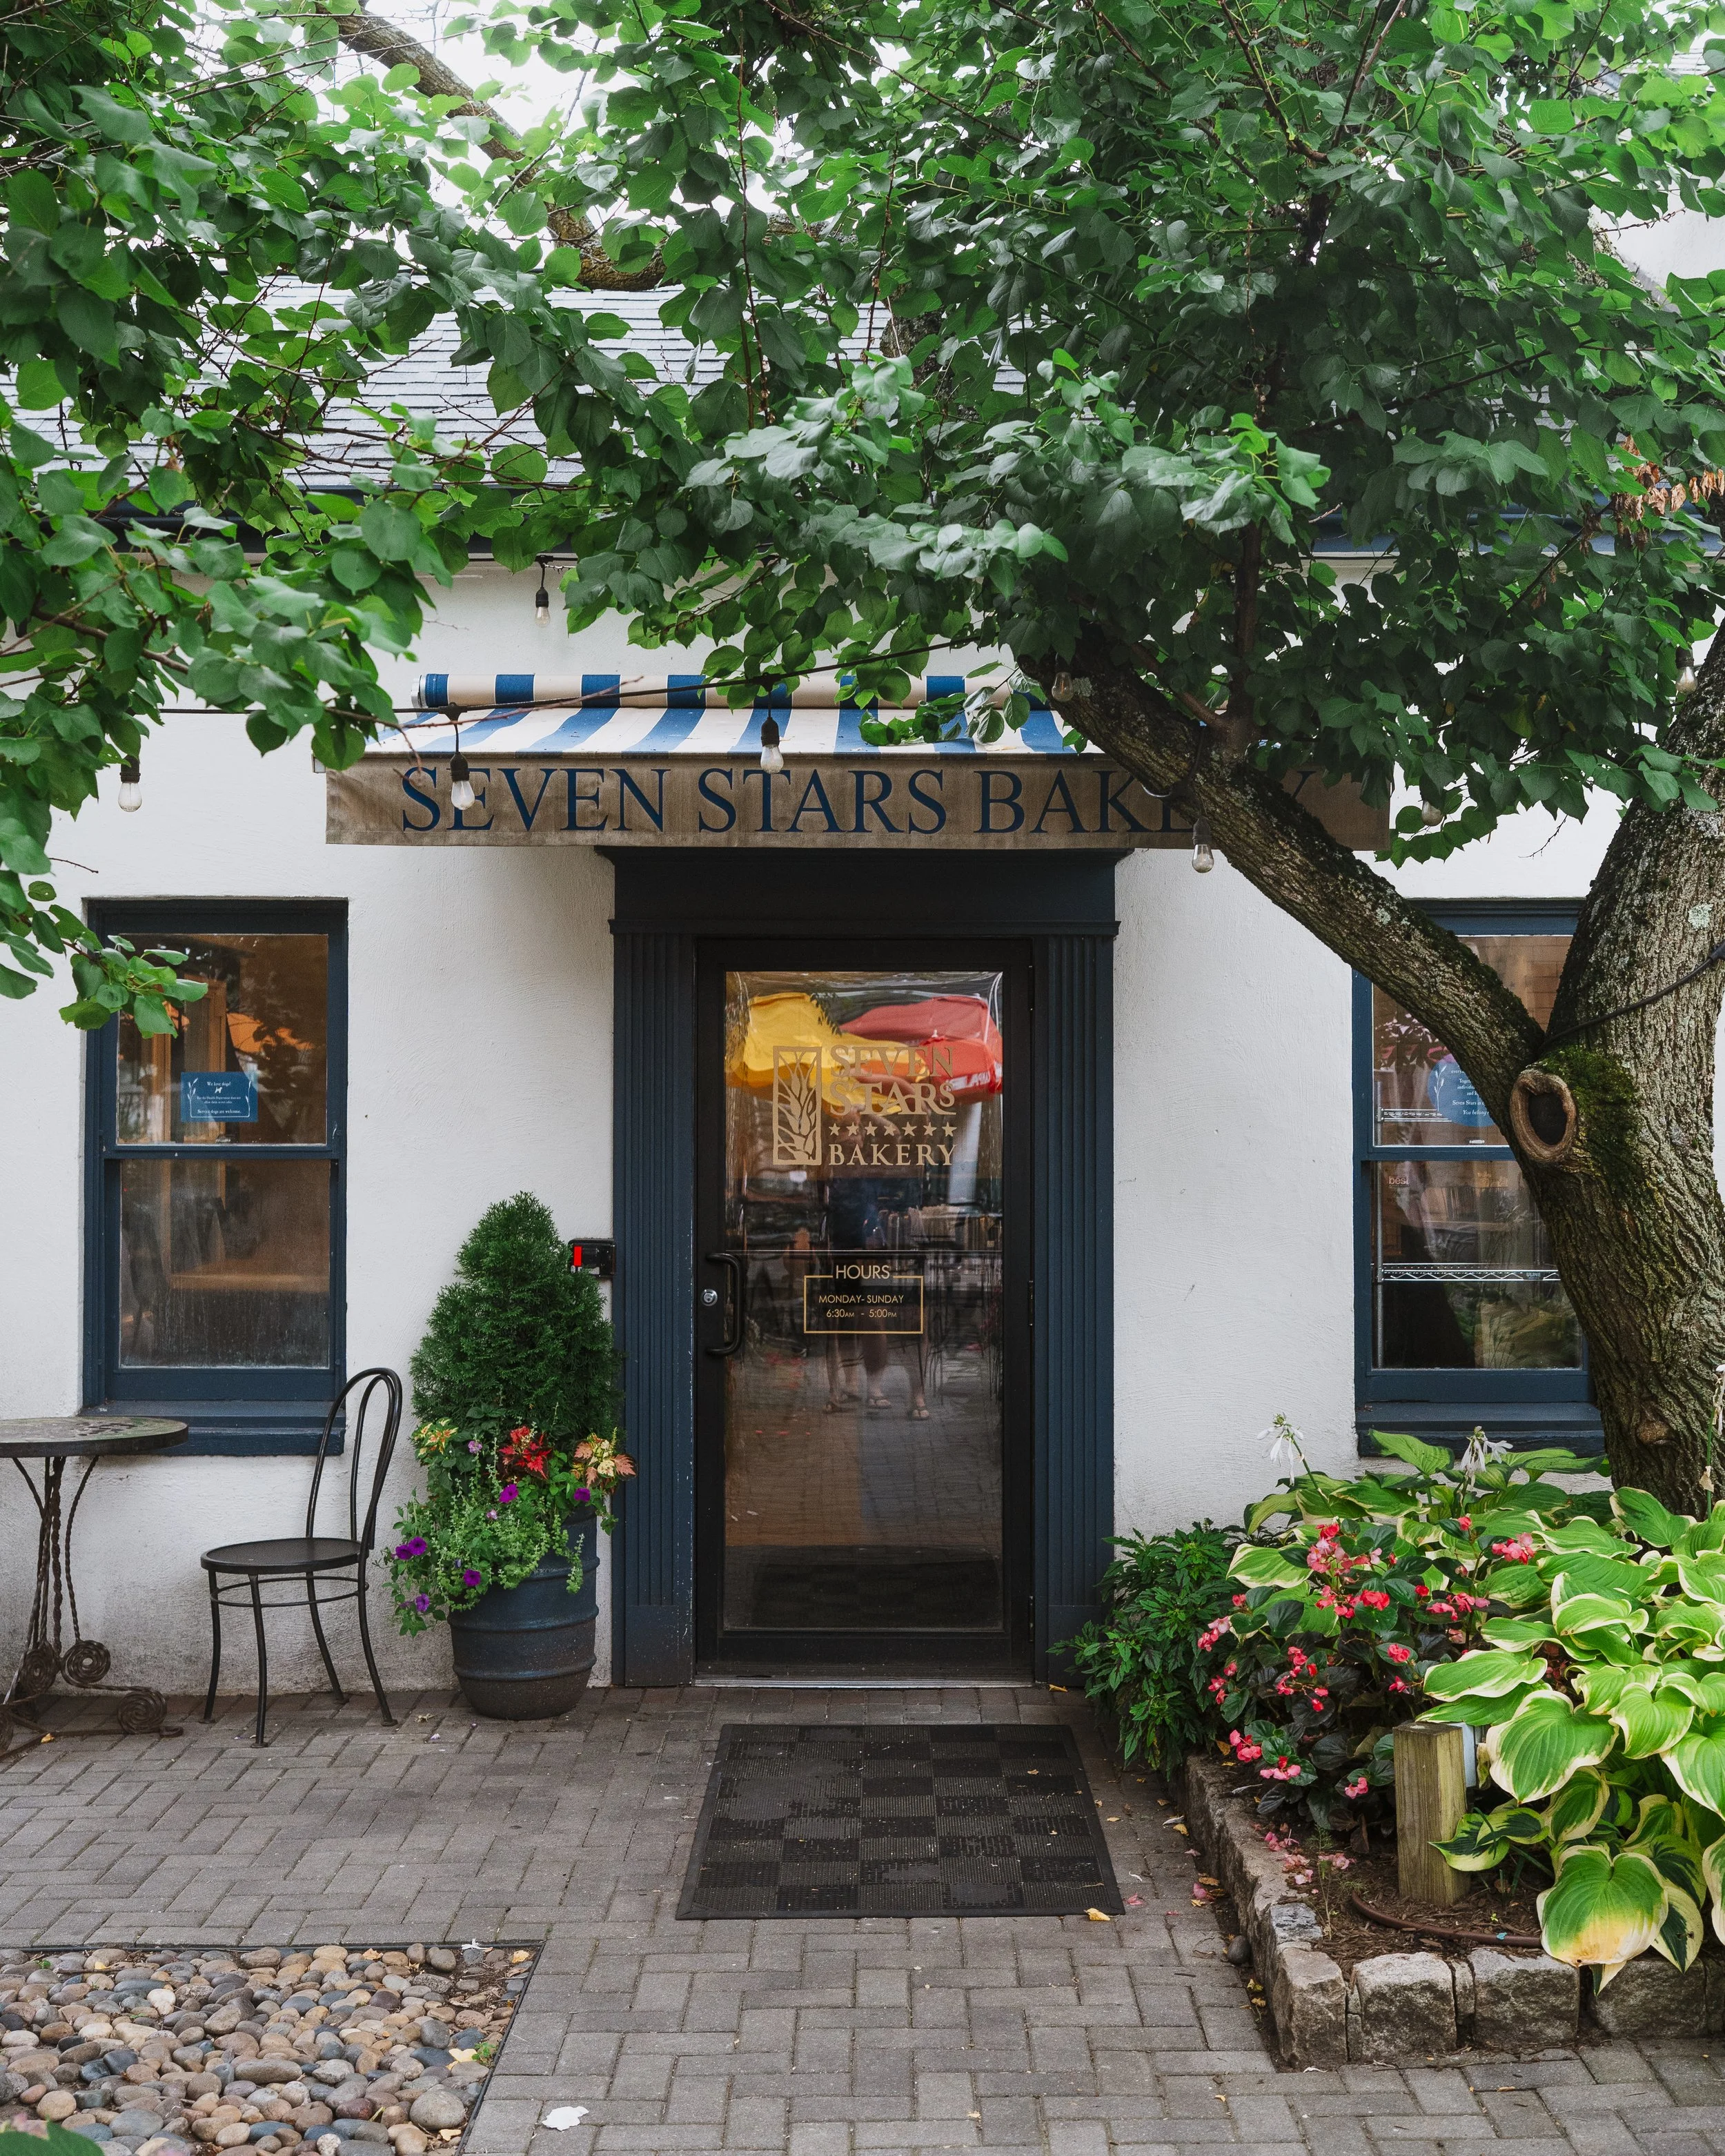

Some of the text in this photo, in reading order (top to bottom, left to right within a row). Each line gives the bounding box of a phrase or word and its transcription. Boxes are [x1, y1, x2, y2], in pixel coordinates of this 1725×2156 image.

[402, 766, 671, 833] SEVEN
[698, 767, 946, 835] STARS
[830, 1045, 953, 1078] SEVEN
[830, 1080, 956, 1116] STARS
[829, 1144, 958, 1166] BAKERY
[836, 1265, 890, 1279] HOURS
[867, 1294, 904, 1303] SUNDAY
[826, 1309, 855, 1318] 6:30AM
[869, 1309, 897, 1318] 5:00PM
